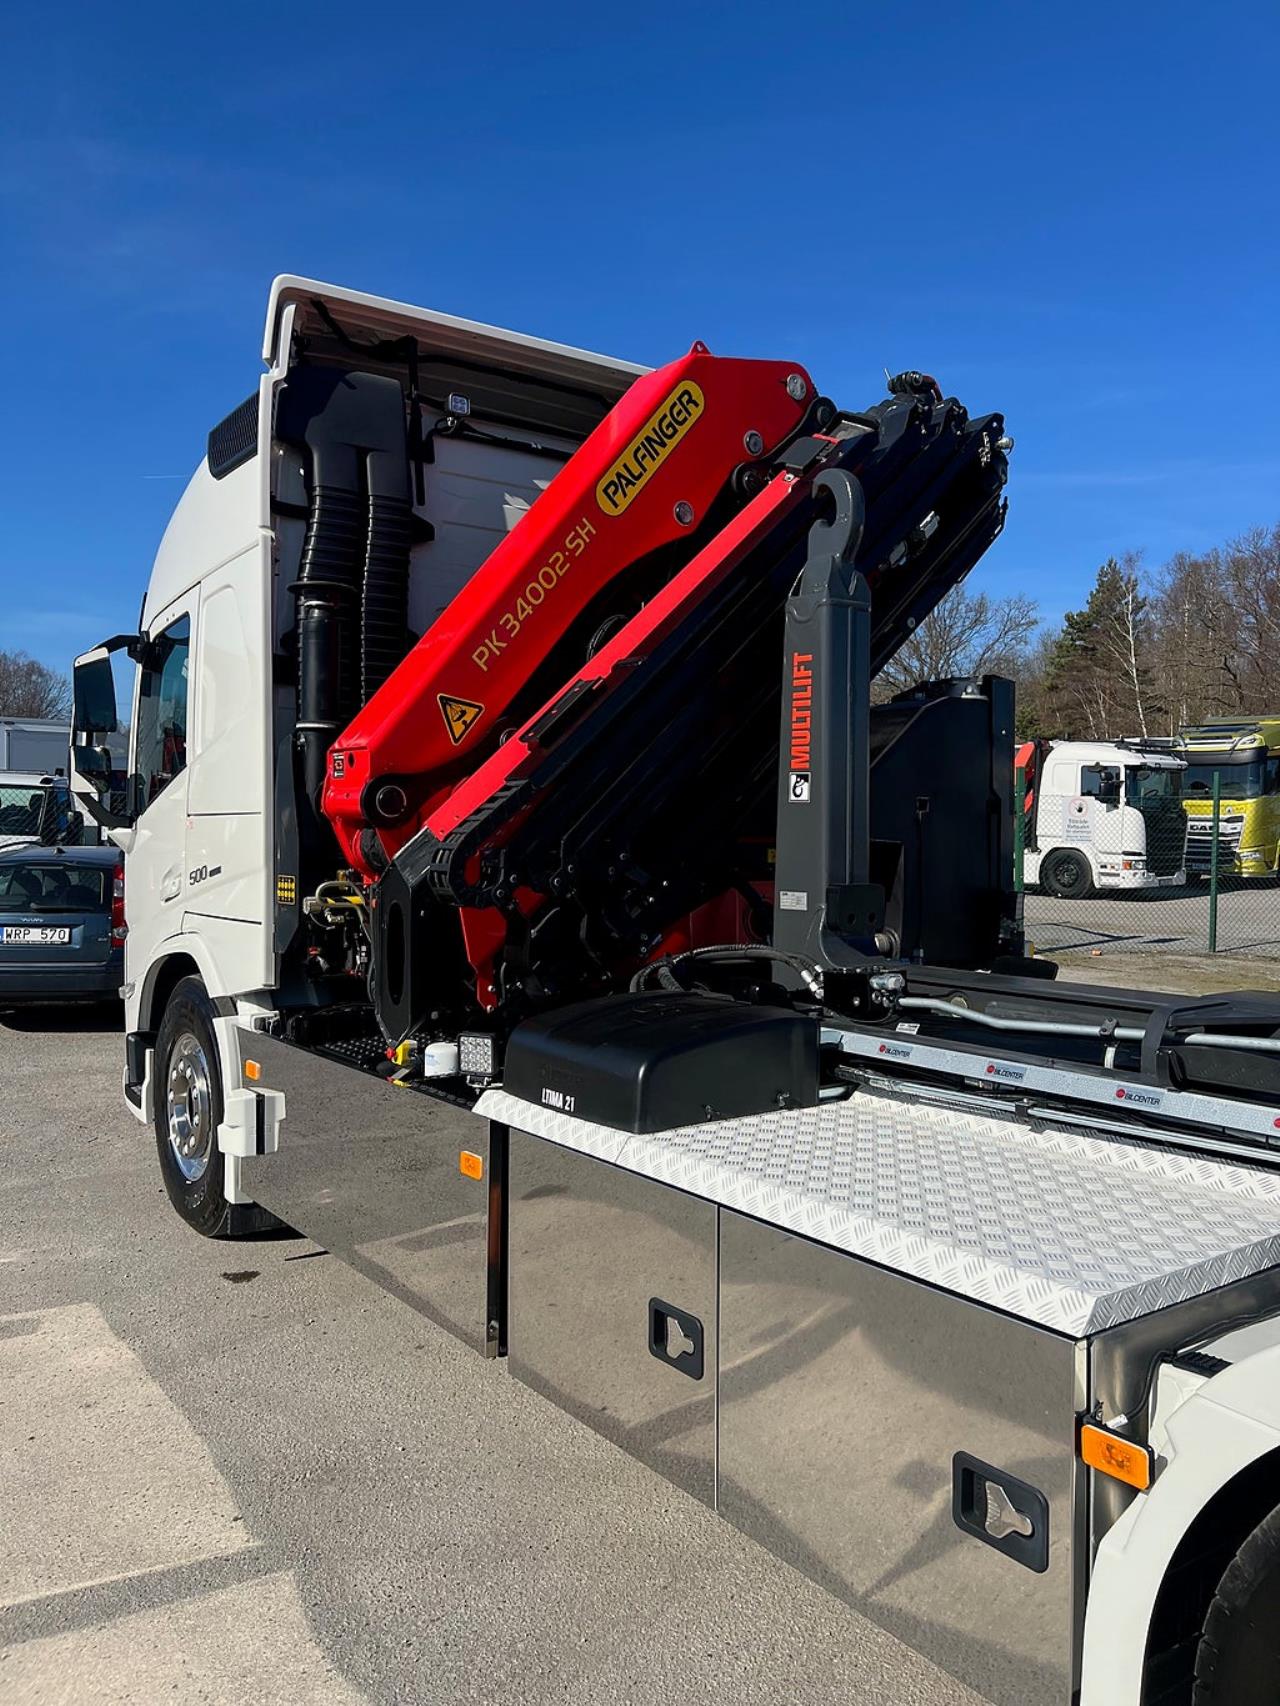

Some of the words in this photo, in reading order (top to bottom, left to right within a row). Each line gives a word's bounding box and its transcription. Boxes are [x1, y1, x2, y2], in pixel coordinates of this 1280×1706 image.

[602, 389, 699, 508] PALFINGER
[472, 631, 507, 672] PK
[790, 652, 813, 769] MULTILIFT
[189, 865, 208, 885] 500
[5, 928, 31, 940] WRP
[40, 928, 66, 940] 570
[564, 1095, 576, 1112] 21
[1125, 1091, 1161, 1106] BILCENTER
